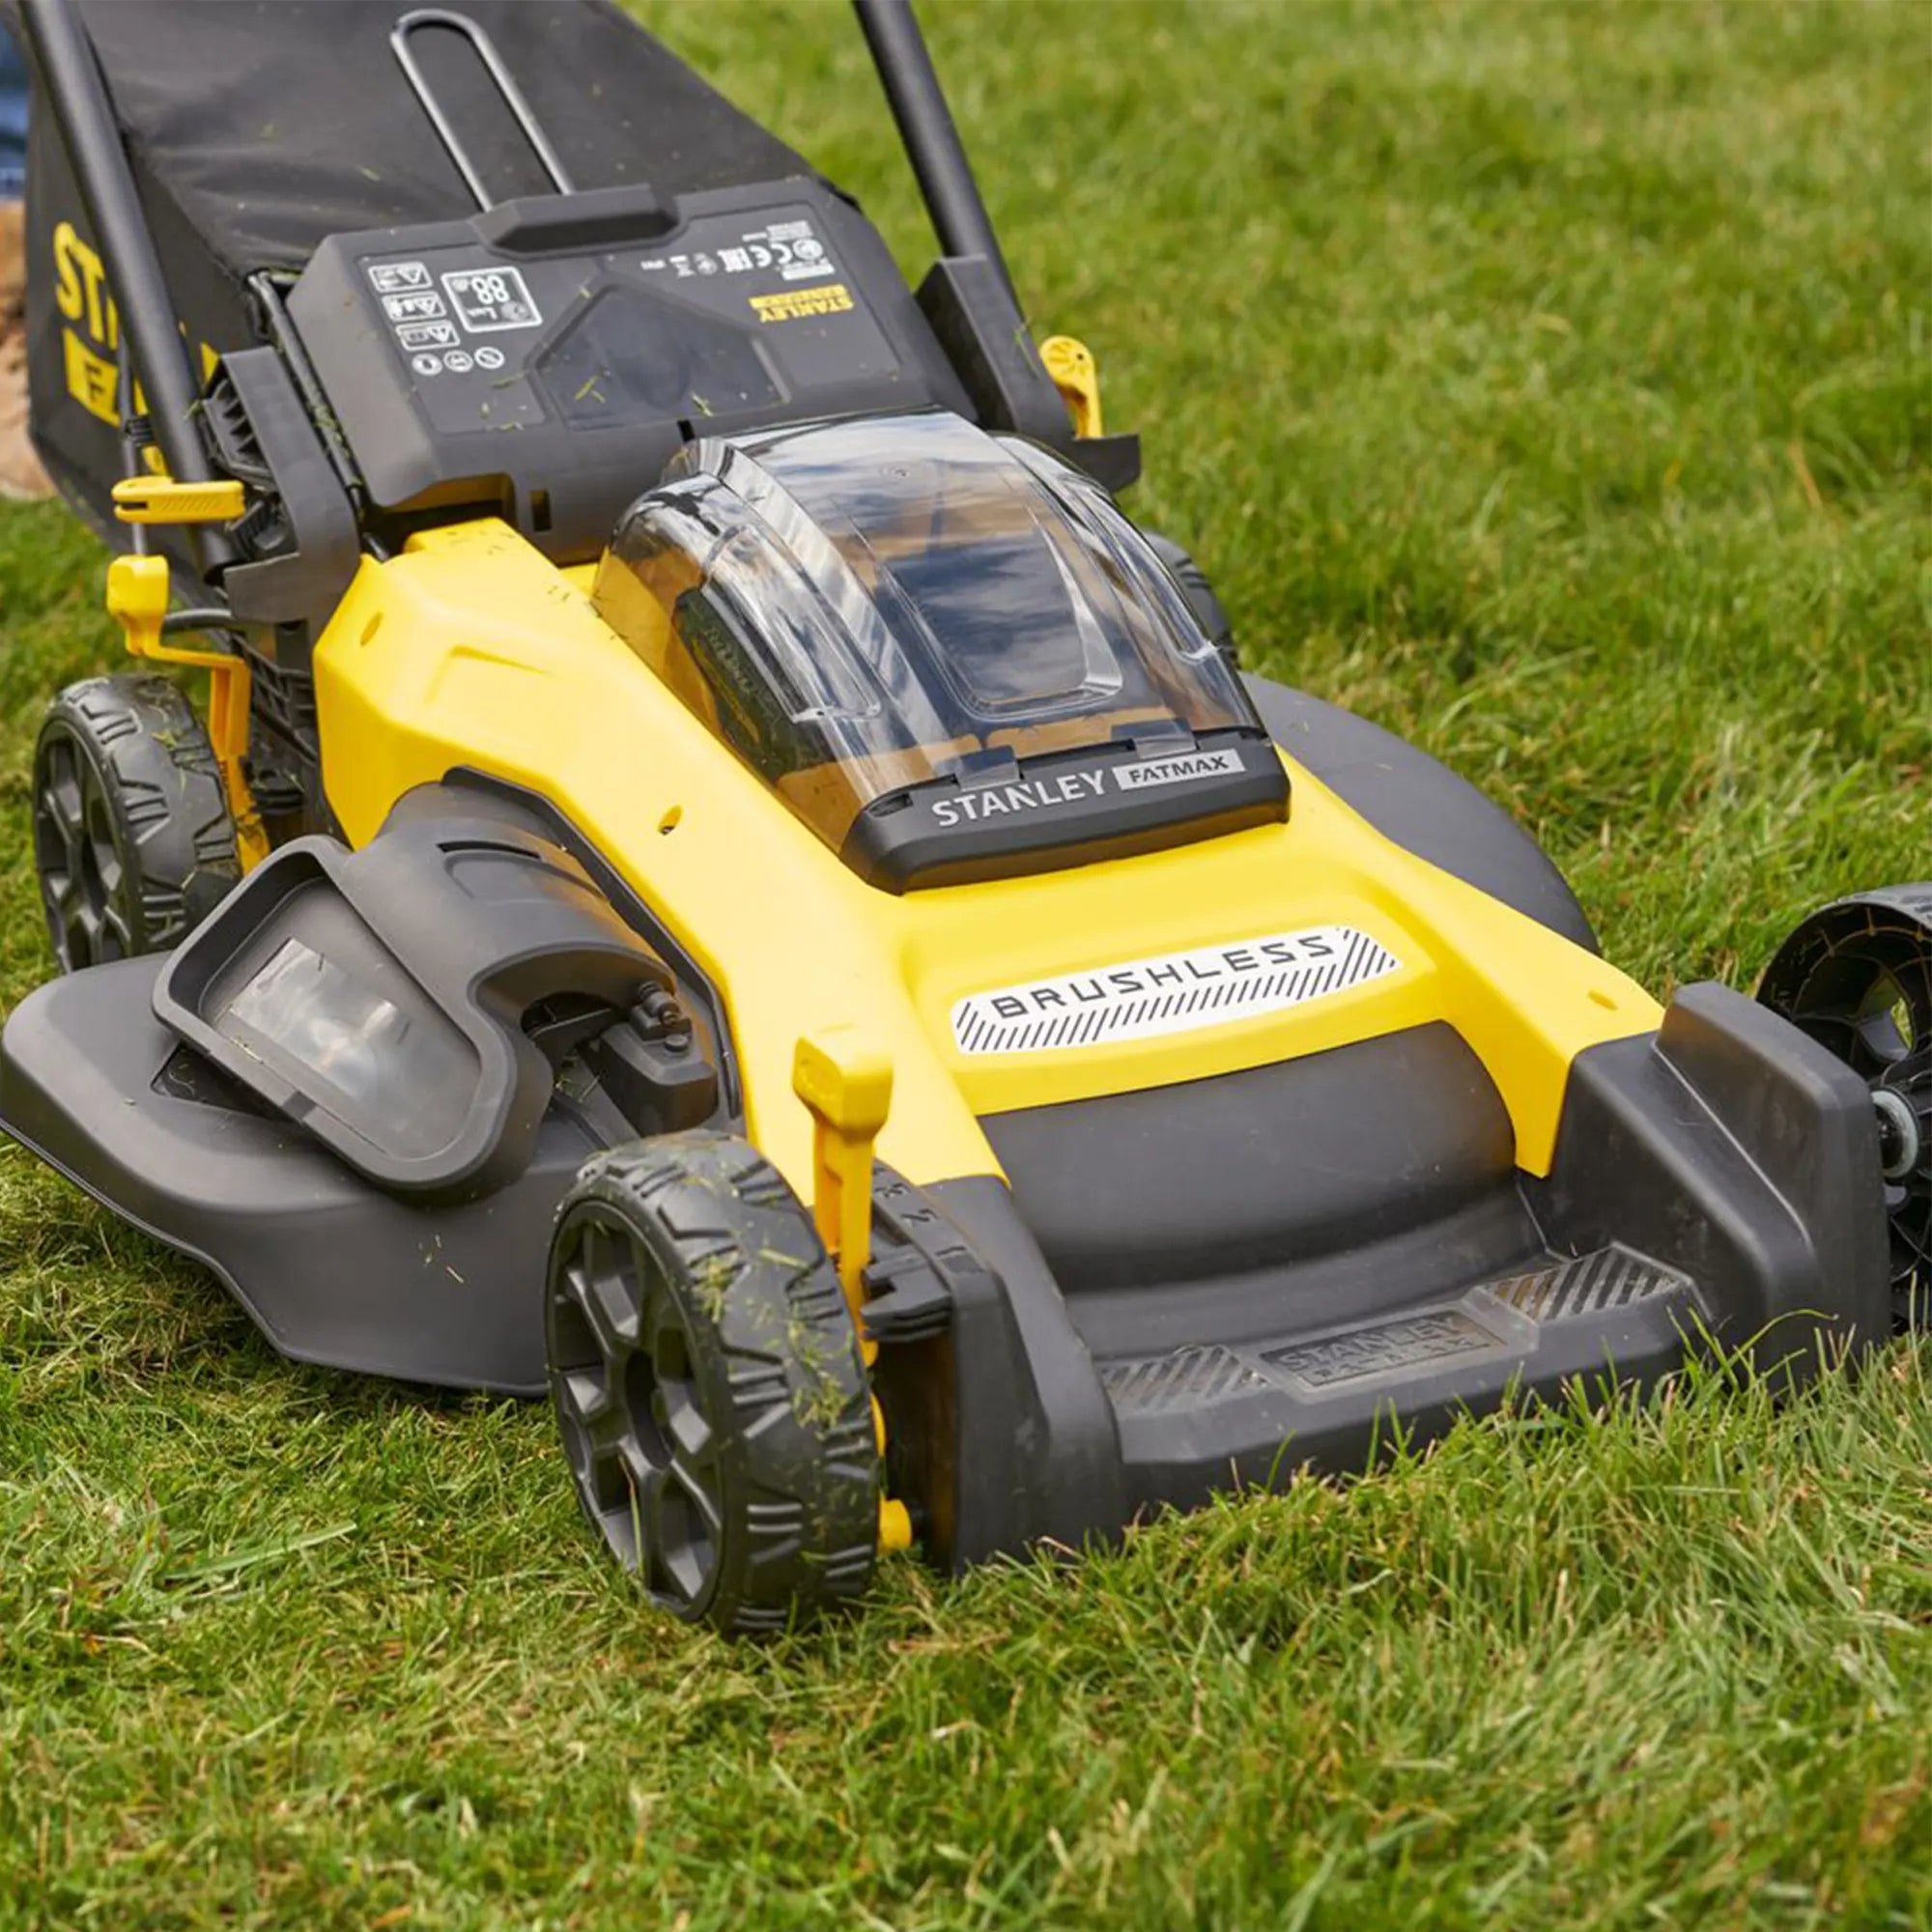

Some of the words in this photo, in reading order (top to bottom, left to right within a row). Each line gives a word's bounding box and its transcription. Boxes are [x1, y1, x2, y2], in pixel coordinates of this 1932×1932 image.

[931, 769, 1106, 828] STANLEY
[1129, 754, 1230, 783] FATMAX
[990, 934, 1334, 1019] BRUSHLESS
[1279, 1316, 1462, 1373] STANLEY
